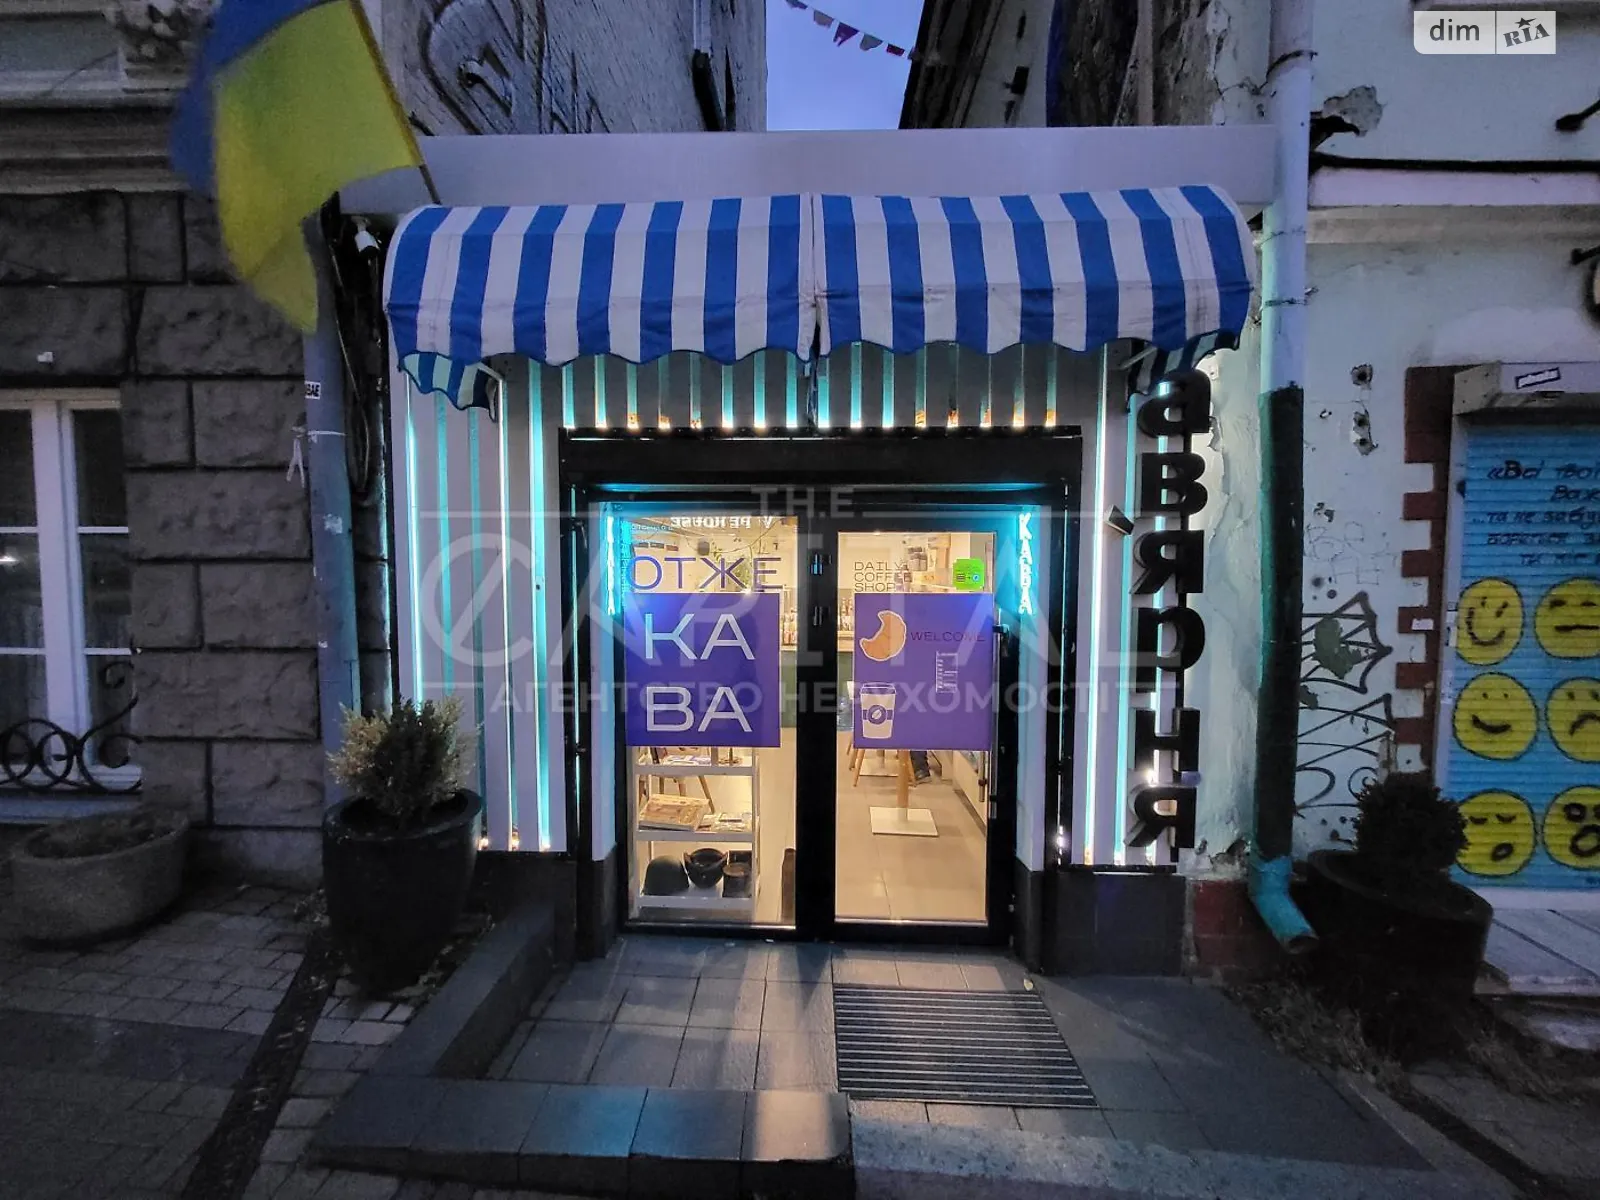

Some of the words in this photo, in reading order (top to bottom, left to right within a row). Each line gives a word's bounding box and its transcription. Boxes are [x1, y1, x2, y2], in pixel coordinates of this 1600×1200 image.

[854, 561, 907, 571] DAILY
[626, 556, 784, 590] ОТЖЕ
[854, 572, 913, 583] COFFEE
[854, 583, 897, 592] SHOP
[645, 613, 756, 660] КА
[910, 631, 987, 642] WELCOME
[646, 686, 753, 733] ВА
